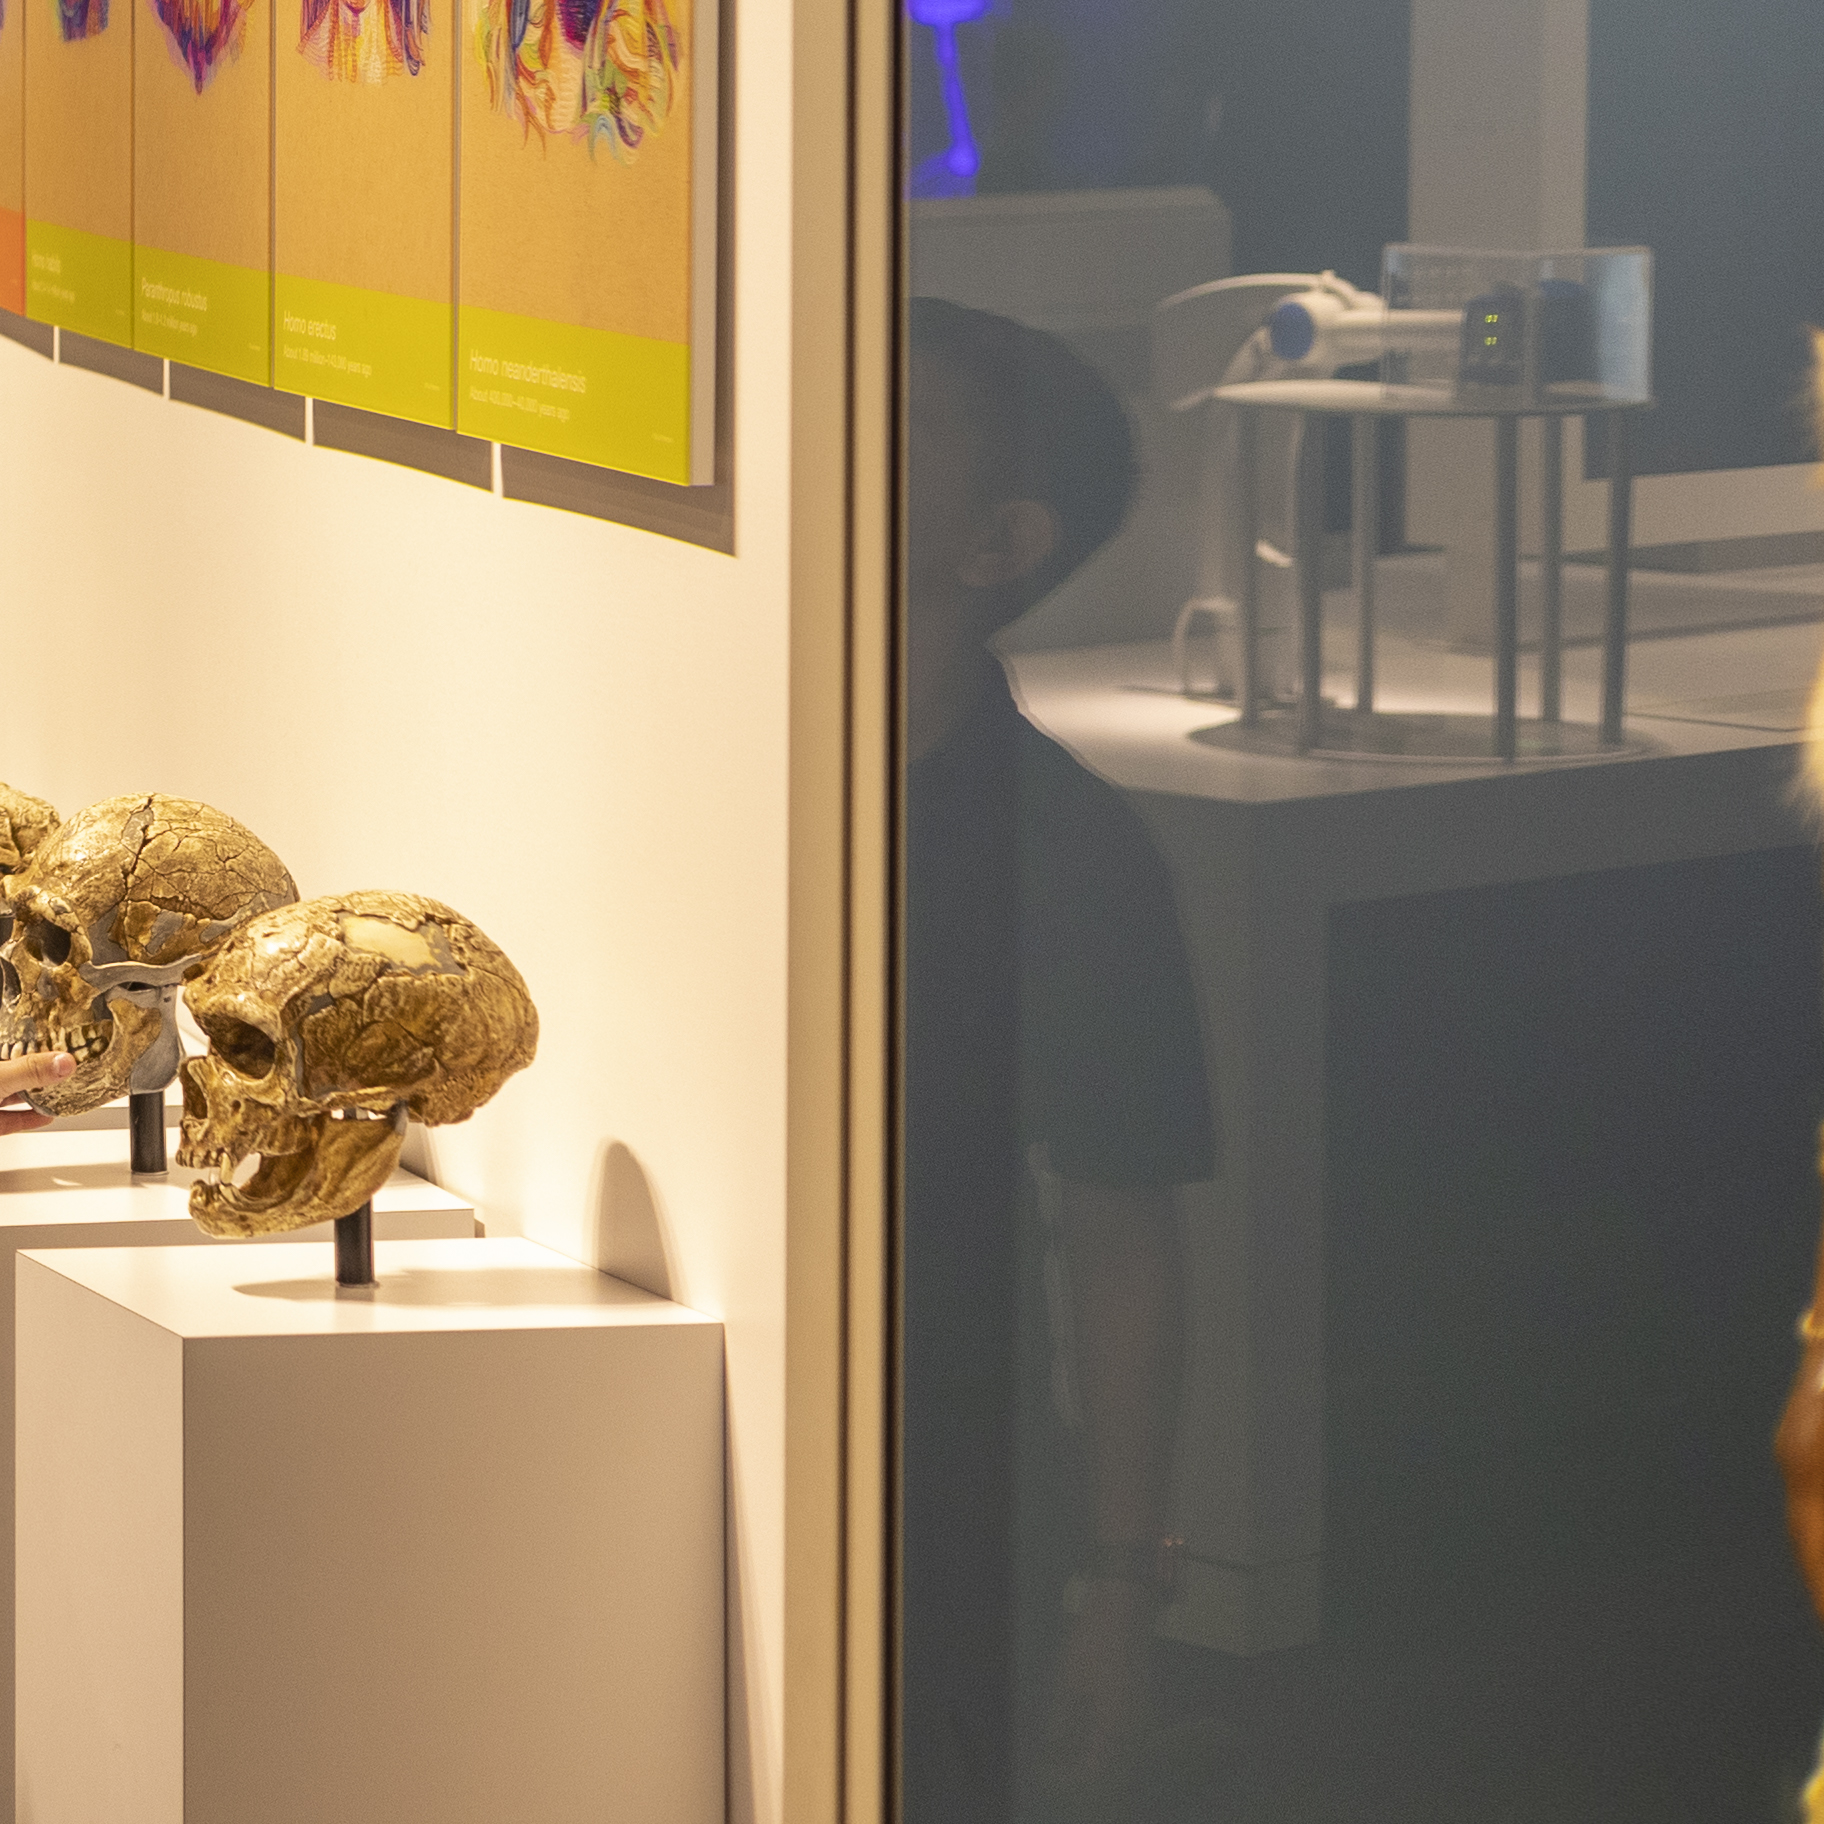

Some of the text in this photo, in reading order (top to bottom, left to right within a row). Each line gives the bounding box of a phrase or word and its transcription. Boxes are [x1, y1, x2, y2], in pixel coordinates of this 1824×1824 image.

[283, 310, 337, 341] Homo erectus
[470, 349, 587, 394] Homo neanderthalensis
